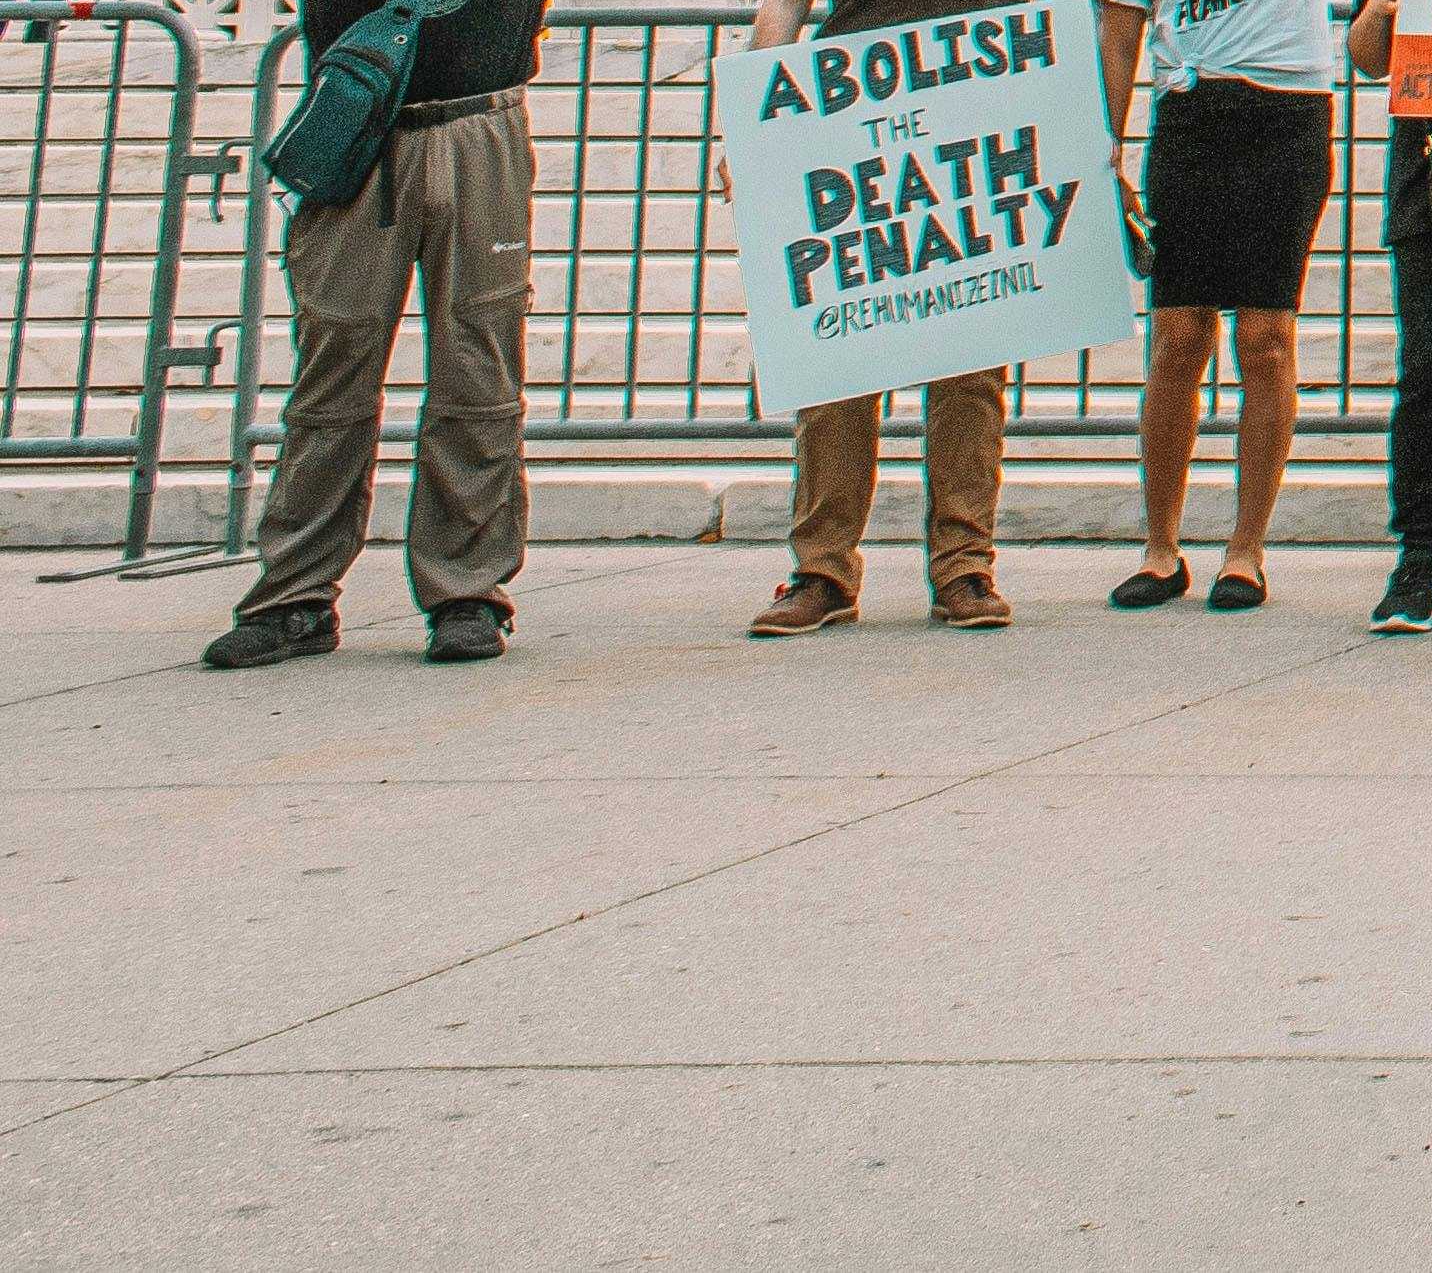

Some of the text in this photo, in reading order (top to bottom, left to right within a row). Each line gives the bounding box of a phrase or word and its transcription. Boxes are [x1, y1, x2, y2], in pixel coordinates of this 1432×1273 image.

[759, 9, 1056, 121] ABOLISH
[803, 125, 1040, 234] DEATH
[861, 107, 930, 148] THE
[784, 180, 1080, 309] PENALTY
[813, 260, 1044, 340] @REHUMANIZEINTL
